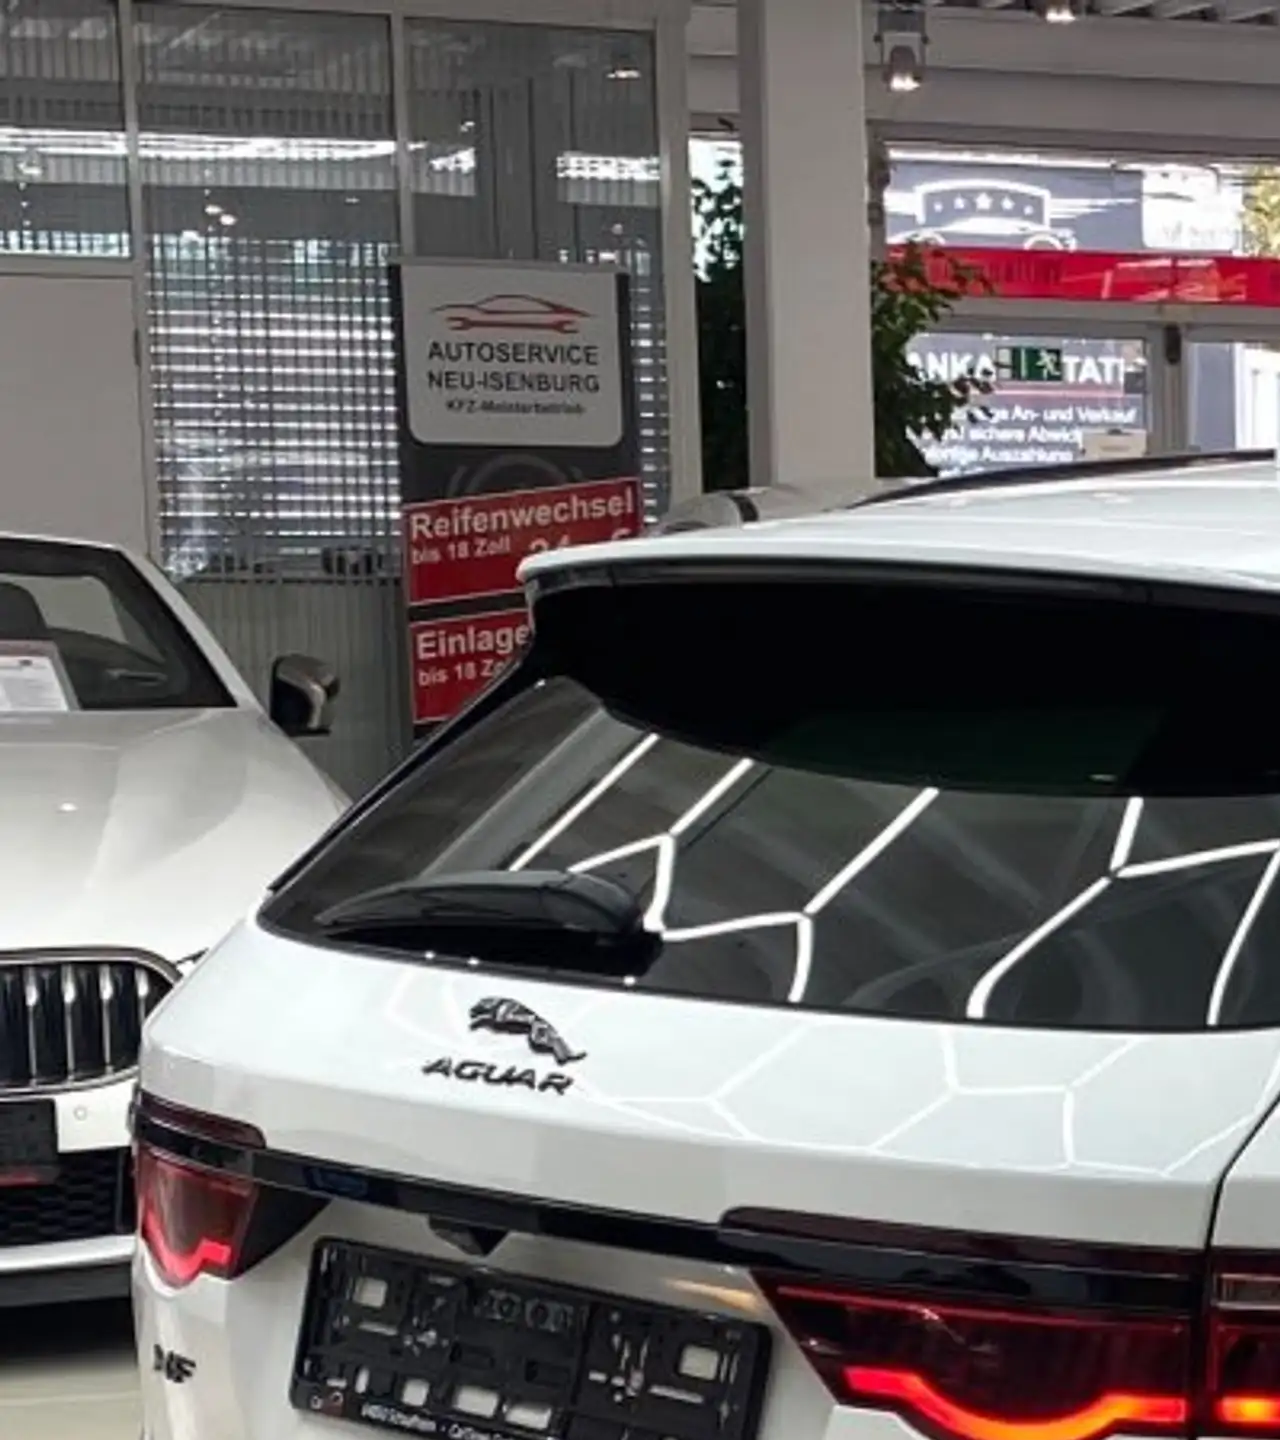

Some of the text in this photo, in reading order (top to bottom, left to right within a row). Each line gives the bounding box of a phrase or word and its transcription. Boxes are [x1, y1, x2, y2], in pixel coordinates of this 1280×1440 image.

[427, 341, 599, 365] AUTOSERVICE
[426, 370, 600, 394] NEU-ISENBURG
[411, 486, 634, 540] Reifenwechsel
[411, 546, 442, 565] bis
[449, 543, 469, 560] 18
[474, 535, 511, 557] Zoll
[417, 668, 449, 687] bis
[455, 662, 477, 681] 18
